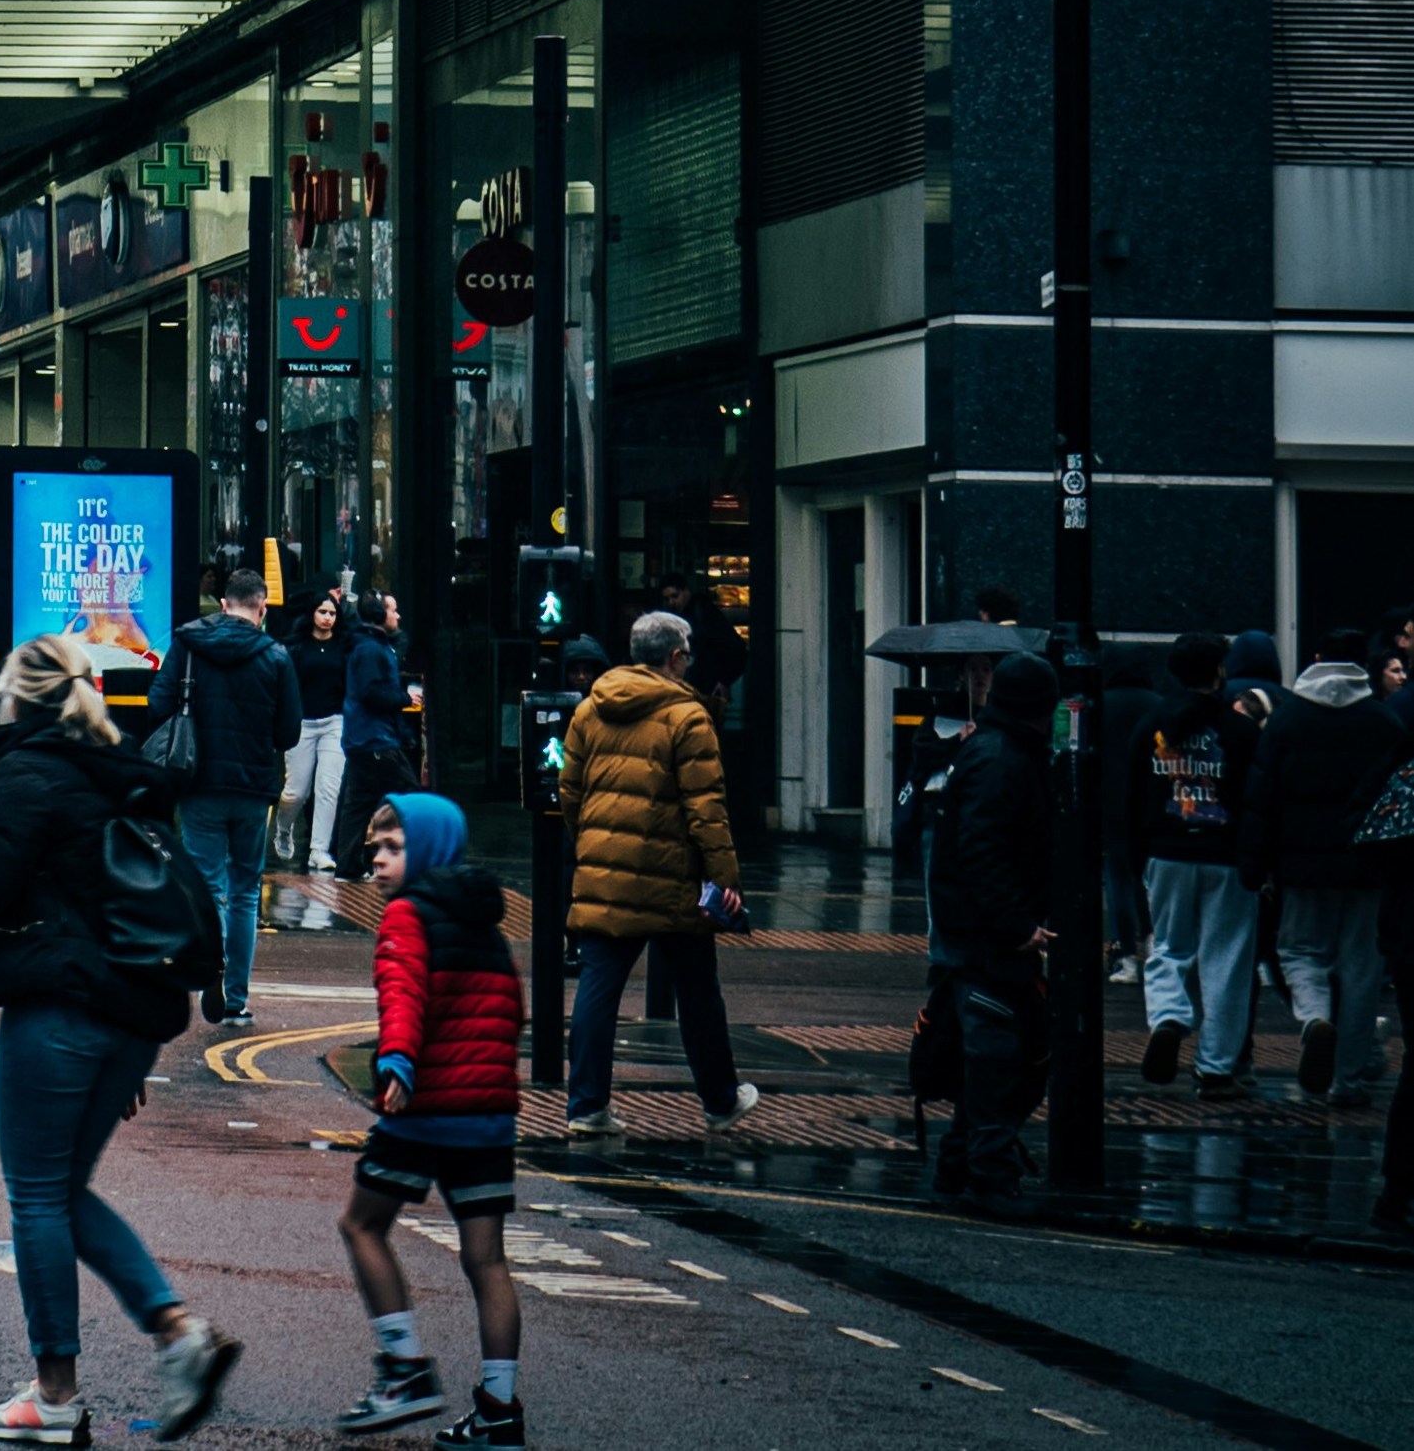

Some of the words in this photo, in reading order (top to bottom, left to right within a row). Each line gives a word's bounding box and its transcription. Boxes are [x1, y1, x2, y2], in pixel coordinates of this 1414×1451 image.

[481, 167, 522, 238] COSTA
[466, 273, 534, 291] COSTA
[288, 363, 318, 372] TRAVEL
[321, 363, 352, 372] MONEY
[41, 522, 73, 543] THE
[78, 524, 144, 543] COLDER
[40, 543, 89, 572] THE
[96, 544, 145, 572] DAY
[41, 572, 67, 589] THE
[71, 573, 110, 589] MORE
[42, 589, 79, 603] YOU'LL
[81, 590, 110, 603] SAVE
